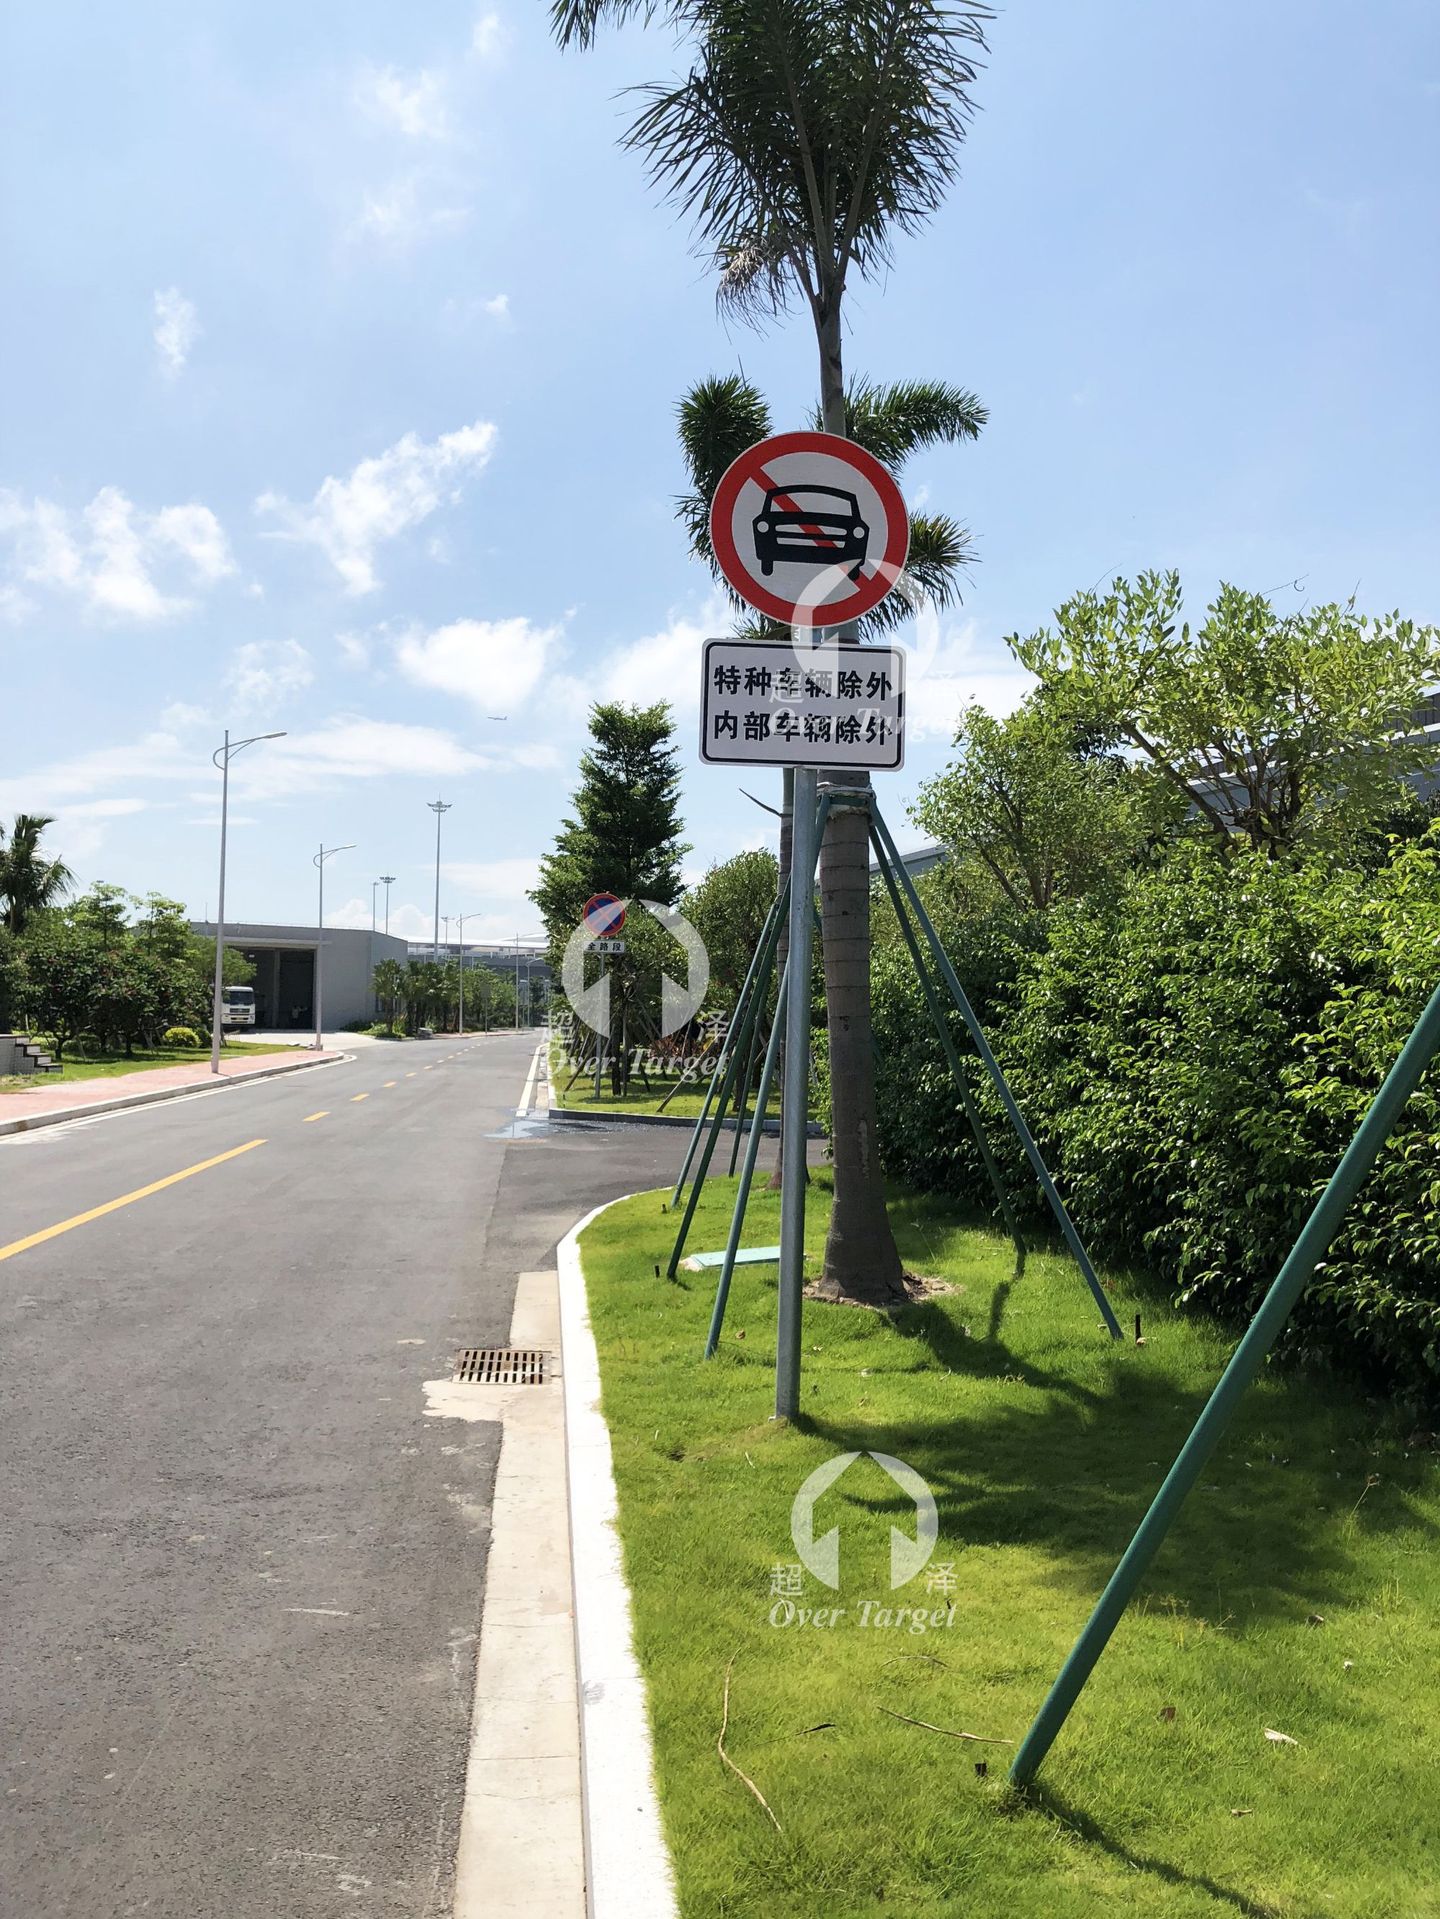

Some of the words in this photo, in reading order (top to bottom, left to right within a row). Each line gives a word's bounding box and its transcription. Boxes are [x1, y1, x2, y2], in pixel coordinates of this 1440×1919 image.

[713, 665, 893, 701] 特种车辆除外
[713, 710, 893, 745] 内部车辆除外
[587, 942, 621, 951] 全路段
